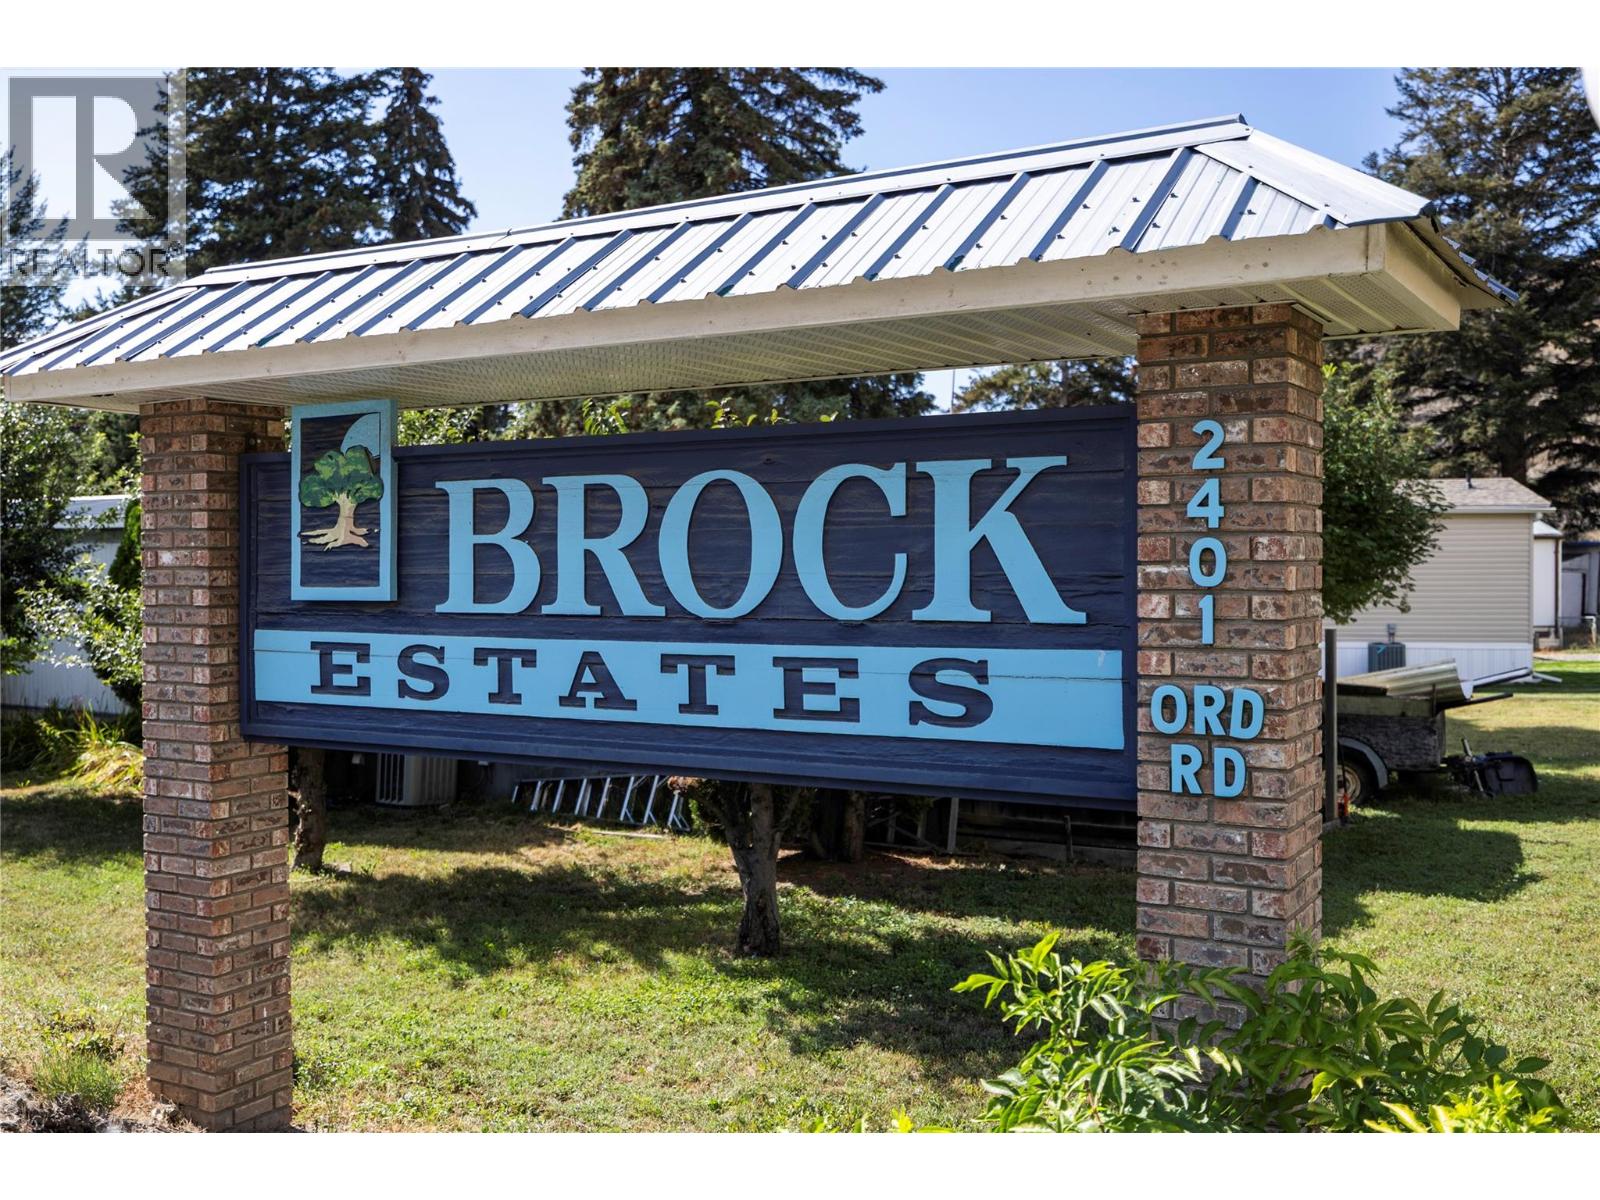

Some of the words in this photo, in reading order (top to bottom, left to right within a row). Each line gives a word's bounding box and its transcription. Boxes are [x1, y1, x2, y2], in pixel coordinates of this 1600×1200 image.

[435, 455, 1087, 624] BROCK
[1186, 419, 1227, 646] 2401
[310, 641, 994, 728] ESTATES
[1150, 684, 1264, 740] ORD
[1170, 743, 1247, 798] RD
